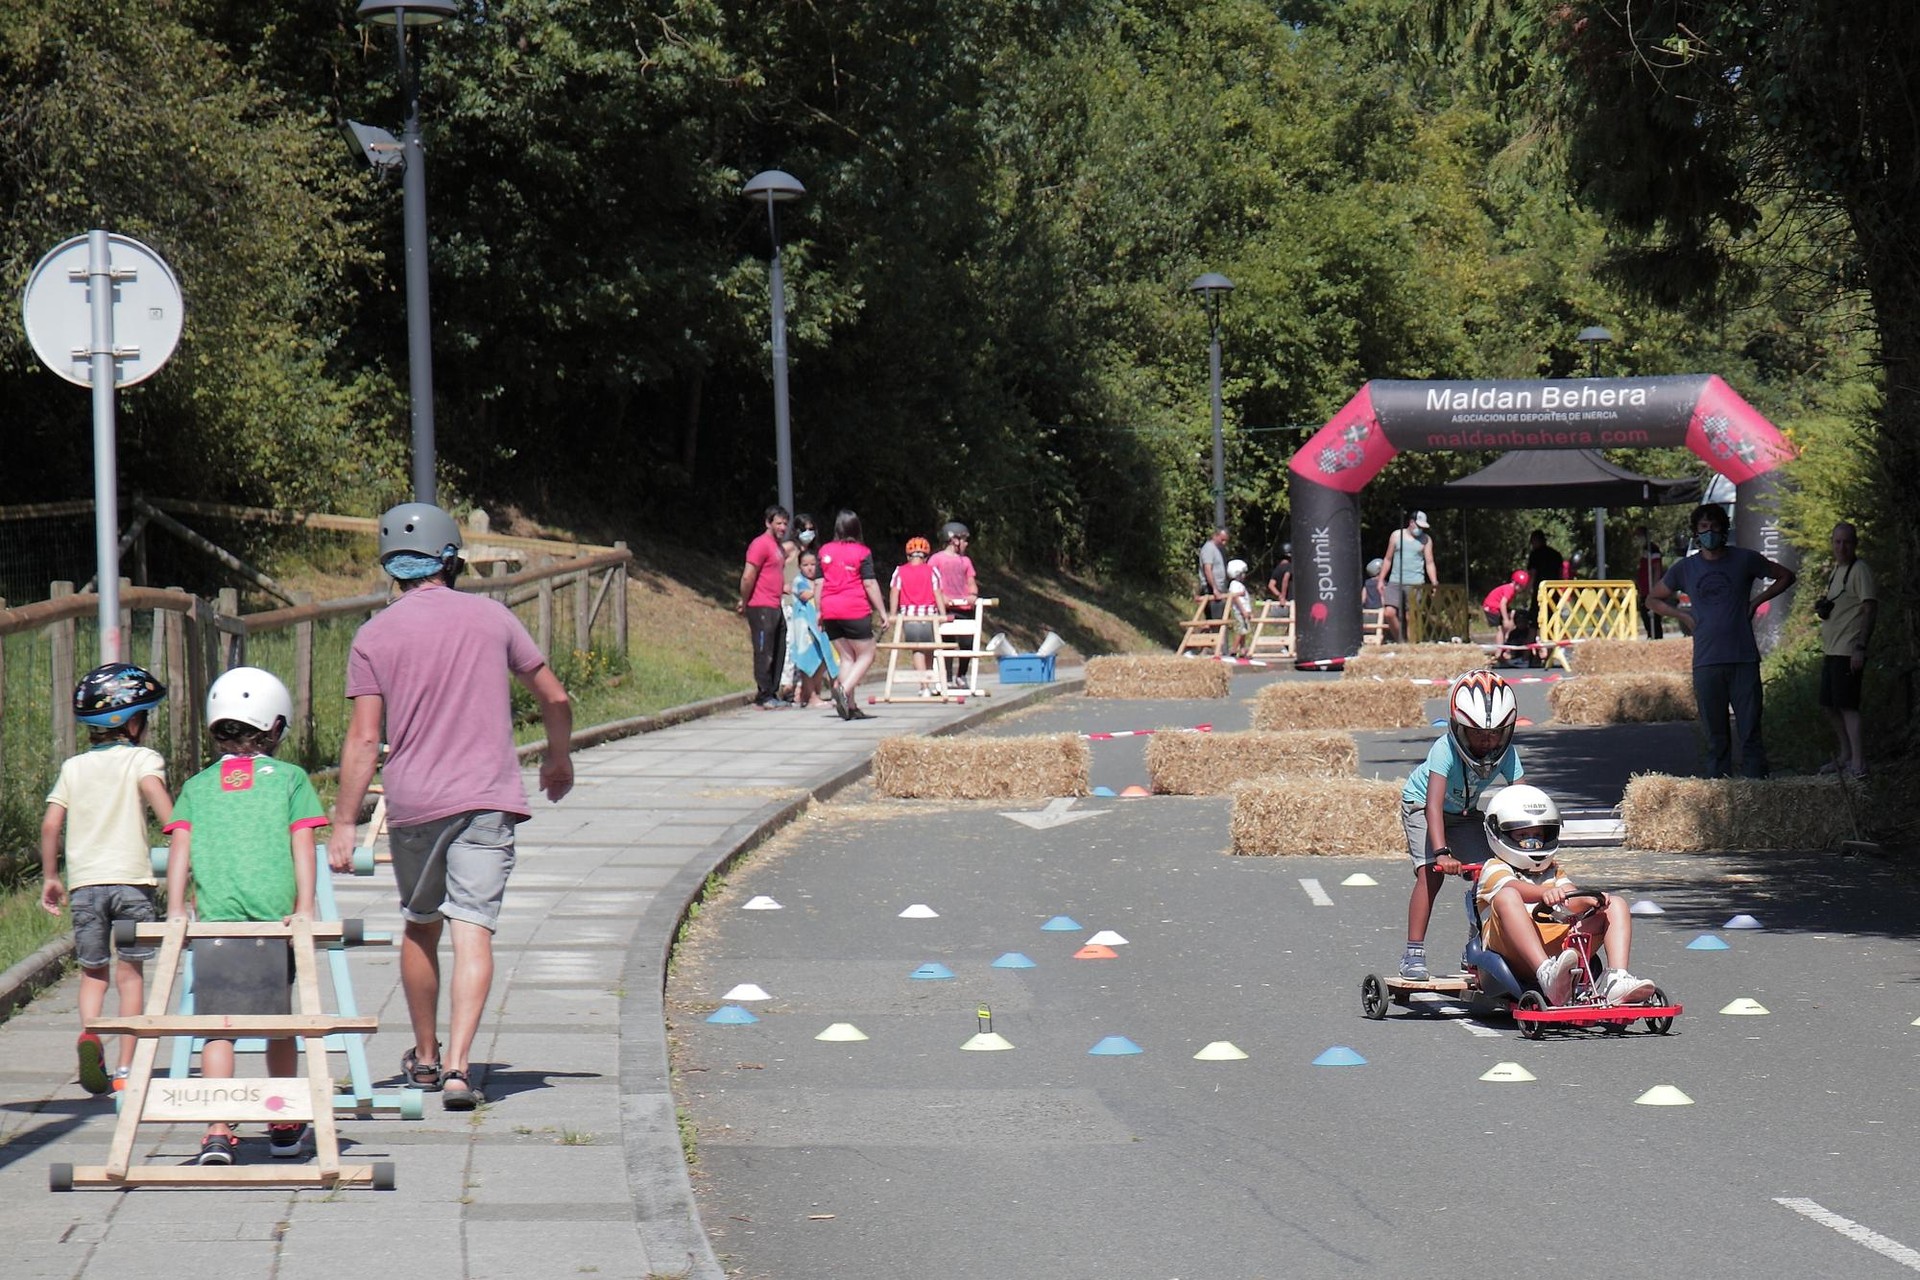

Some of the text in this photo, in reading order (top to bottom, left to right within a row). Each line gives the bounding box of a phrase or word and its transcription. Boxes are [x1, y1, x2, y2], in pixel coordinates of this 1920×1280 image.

[1426, 386, 1646, 410] Maldan Behera
[1451, 414, 1505, 422] ASOCIACION
[1520, 412, 1567, 421] DEPORTES
[1568, 412, 1580, 420] DE
[1582, 411, 1618, 419] INERCIA
[1311, 527, 1337, 600] sputnik
[163, 1086, 260, 1106] sputnik
